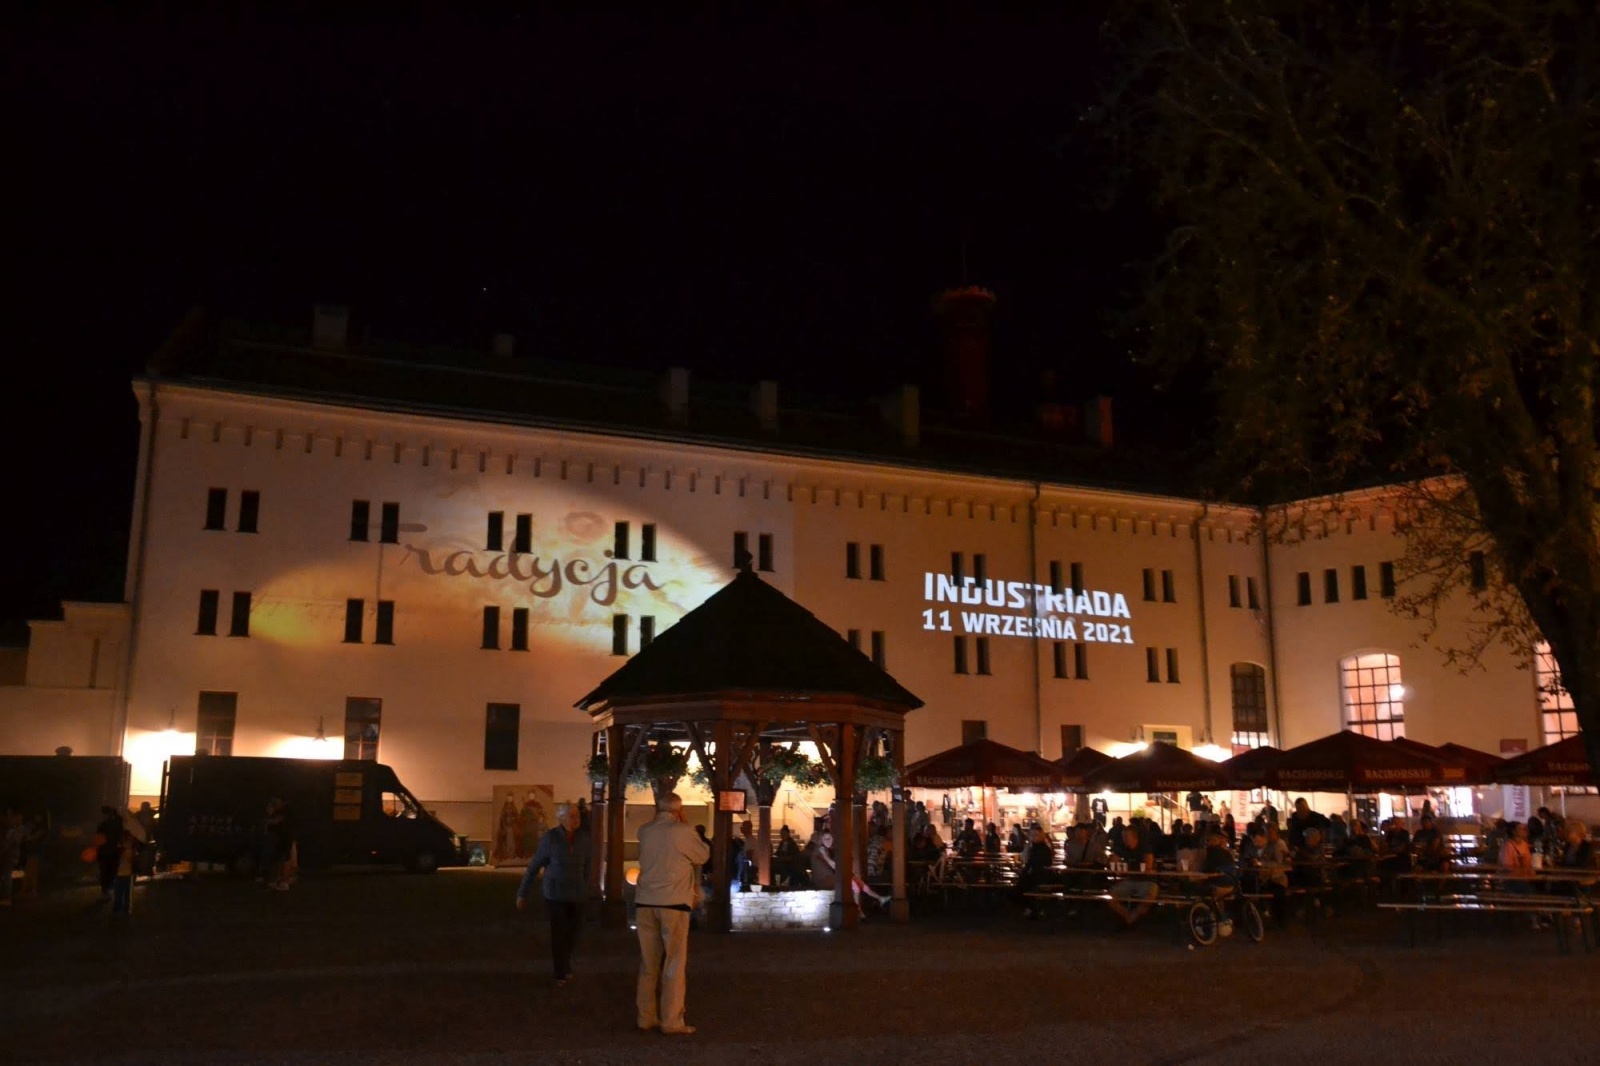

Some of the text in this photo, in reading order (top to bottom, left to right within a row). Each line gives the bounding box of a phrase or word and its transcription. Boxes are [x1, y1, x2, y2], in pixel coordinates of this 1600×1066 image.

[923, 571, 1132, 619] INDUSTRIADA
[921, 608, 953, 632] 11
[1083, 621, 1134, 645] 2021
